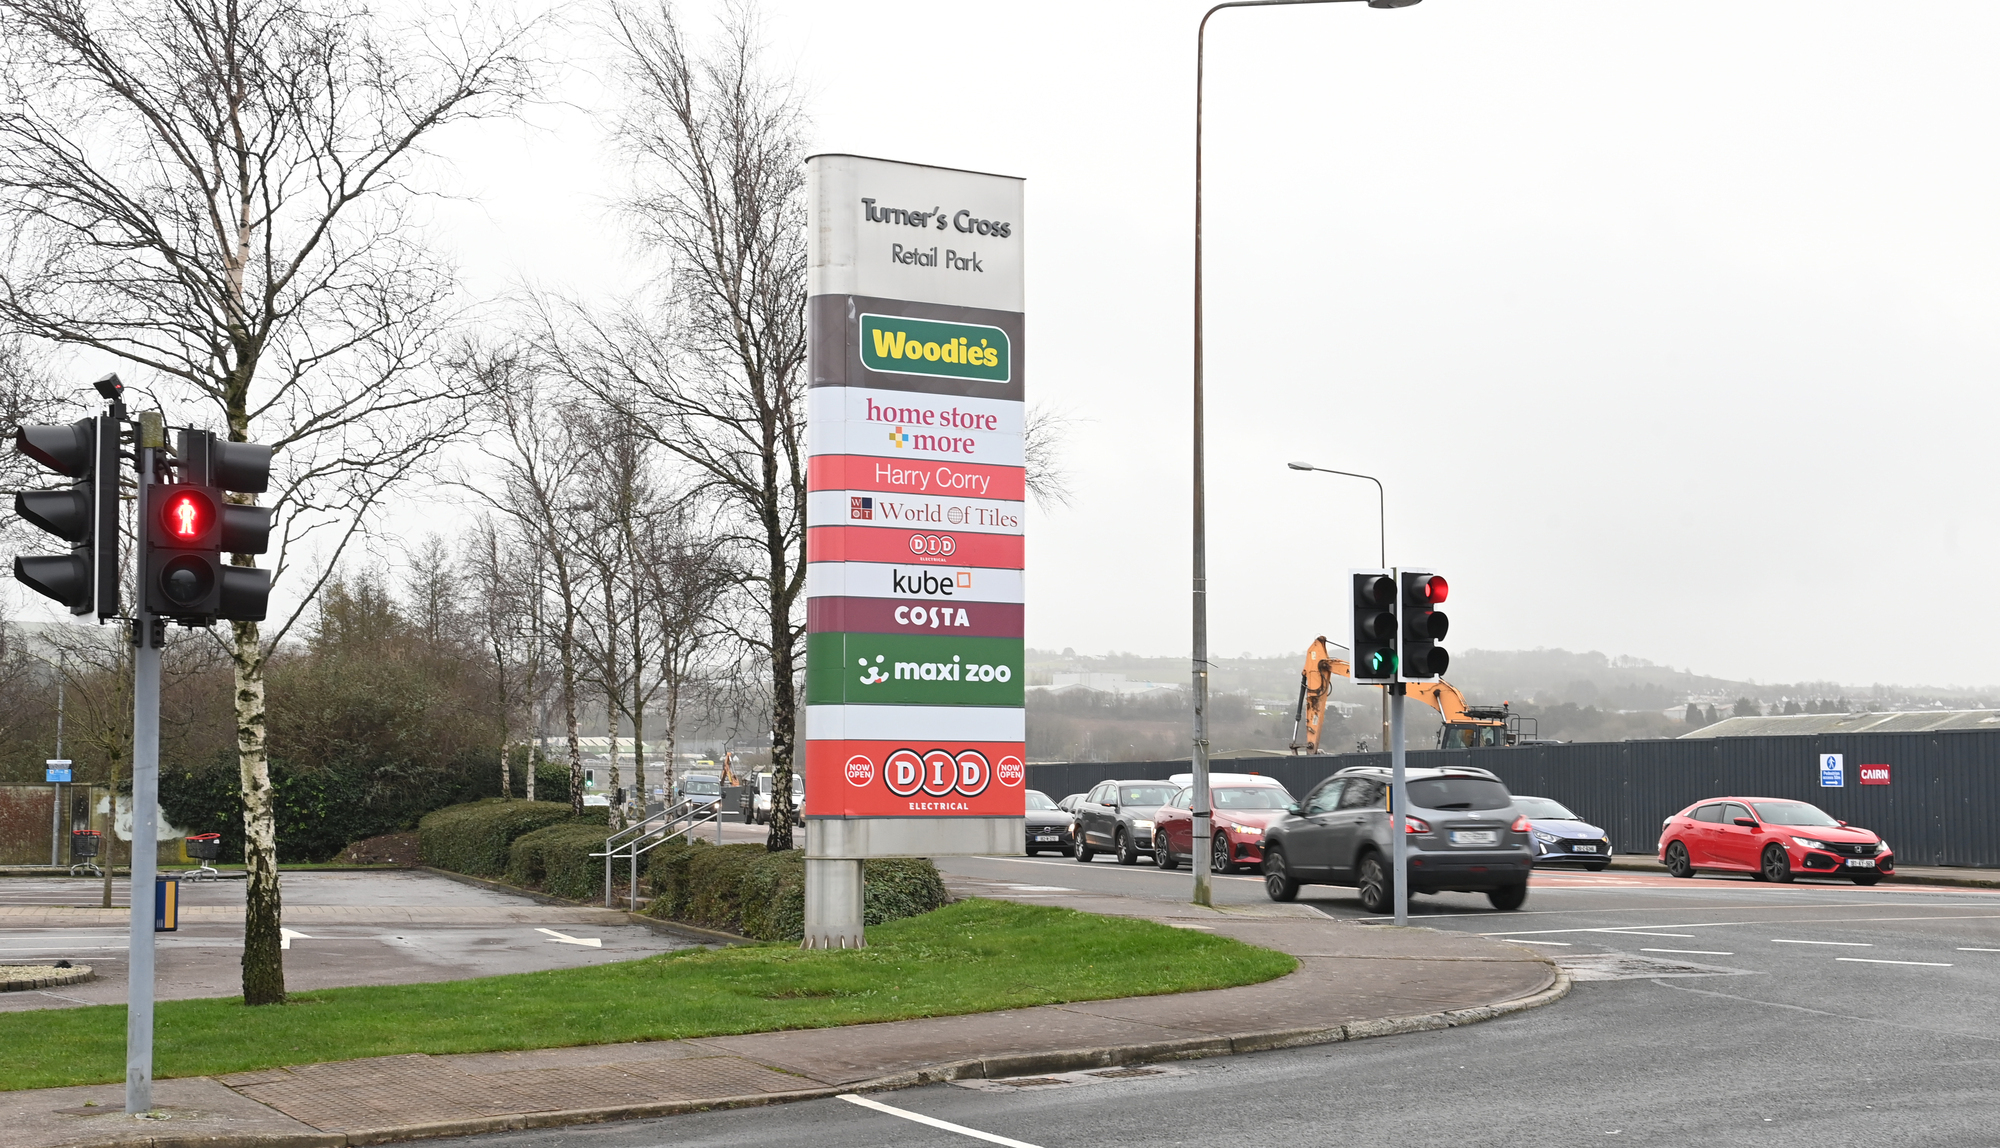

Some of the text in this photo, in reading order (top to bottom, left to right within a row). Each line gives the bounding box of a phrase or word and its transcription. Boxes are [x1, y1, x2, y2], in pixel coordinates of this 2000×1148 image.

[861, 198, 1012, 238] Turner's Cross
[892, 243, 984, 273] Retail Park
[872, 328, 999, 367] Woodie's
[866, 397, 998, 431] home store
[912, 433, 975, 454] more
[875, 462, 991, 494] Harry Corry
[879, 501, 942, 524] World
[975, 507, 1018, 528] Tiles
[914, 538, 952, 552] DID
[893, 568, 954, 596] kube
[894, 605, 970, 629] COSTA
[894, 654, 1012, 683] maxi zoo
[848, 770, 871, 779] OPEN
[849, 763, 870, 771] NOW
[895, 761, 980, 786] DID
[1000, 771, 1021, 779] OPEN
[1860, 769, 1889, 780] CAIRN
[909, 802, 969, 810] ELECTRICAL
